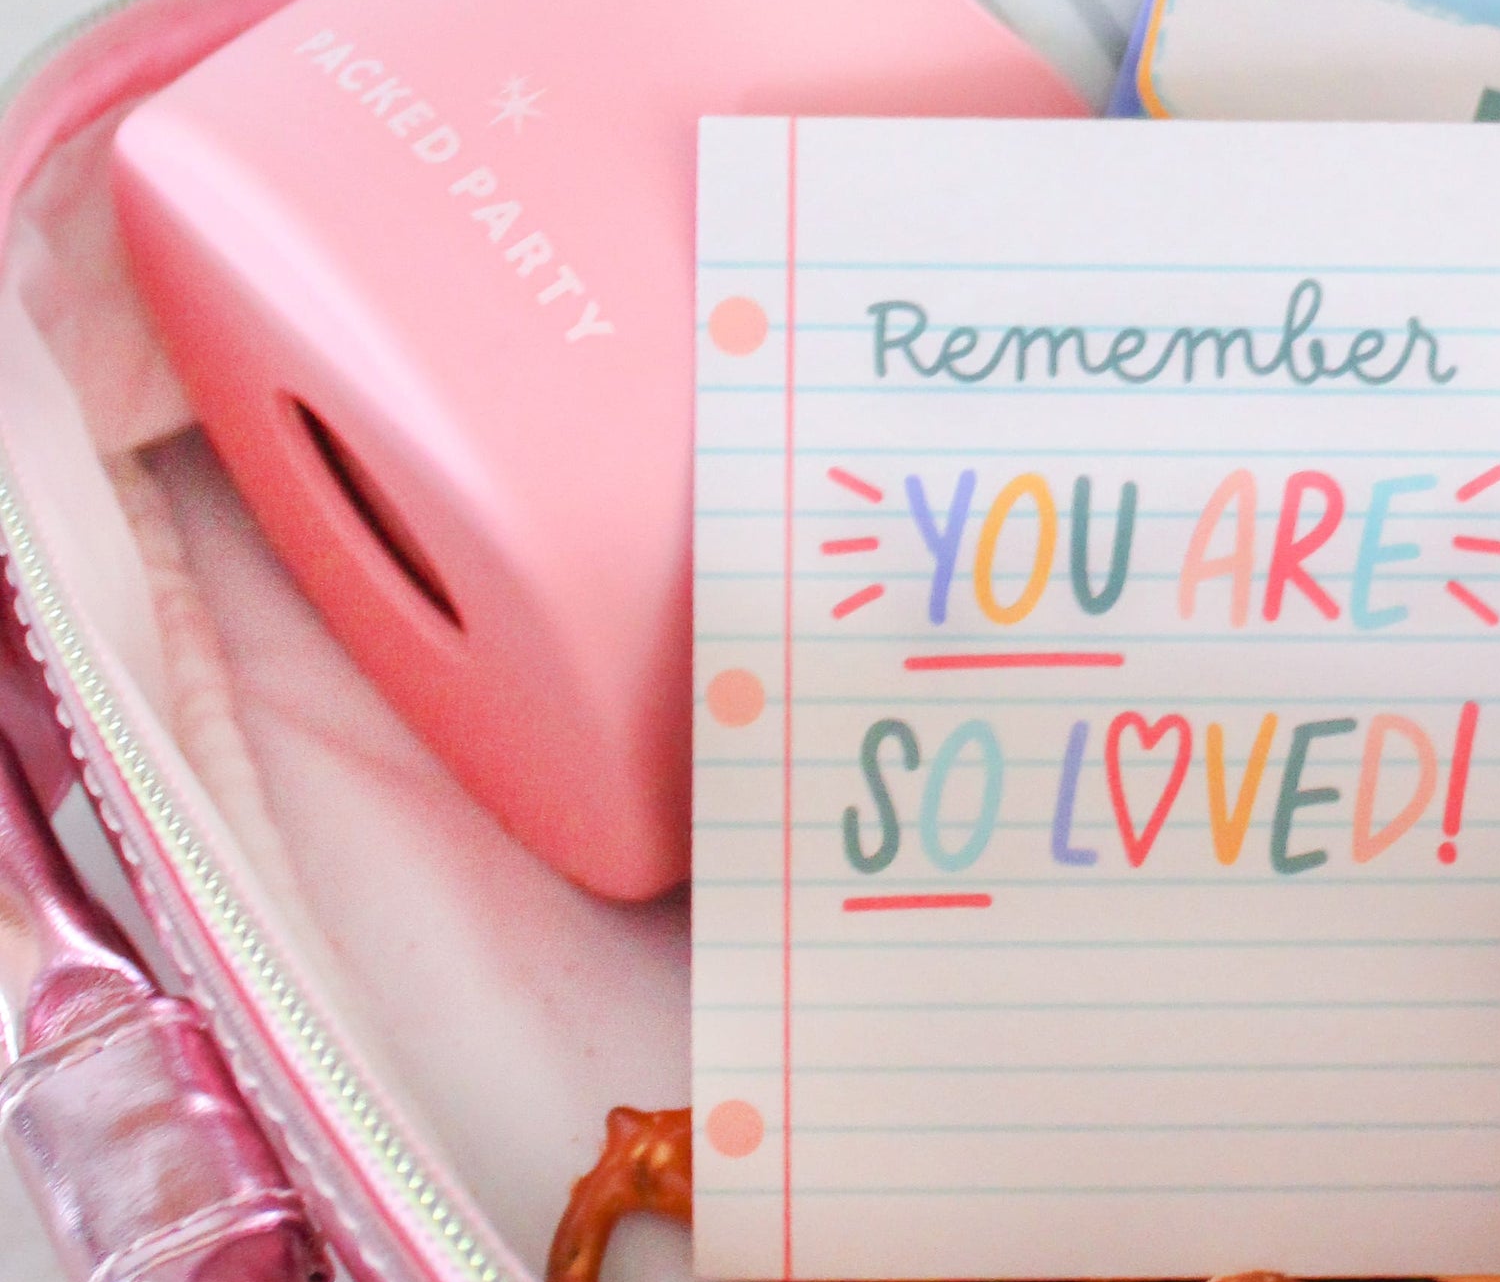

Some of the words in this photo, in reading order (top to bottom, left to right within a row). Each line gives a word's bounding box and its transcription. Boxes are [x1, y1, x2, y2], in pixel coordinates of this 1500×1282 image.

[294, 29, 461, 163] PACKED
[449, 167, 615, 343] PARTY
[867, 278, 1457, 384] Remember
[904, 470, 1137, 624] YOU
[1178, 469, 1438, 628] ARE
[843, 720, 1004, 873] SO
